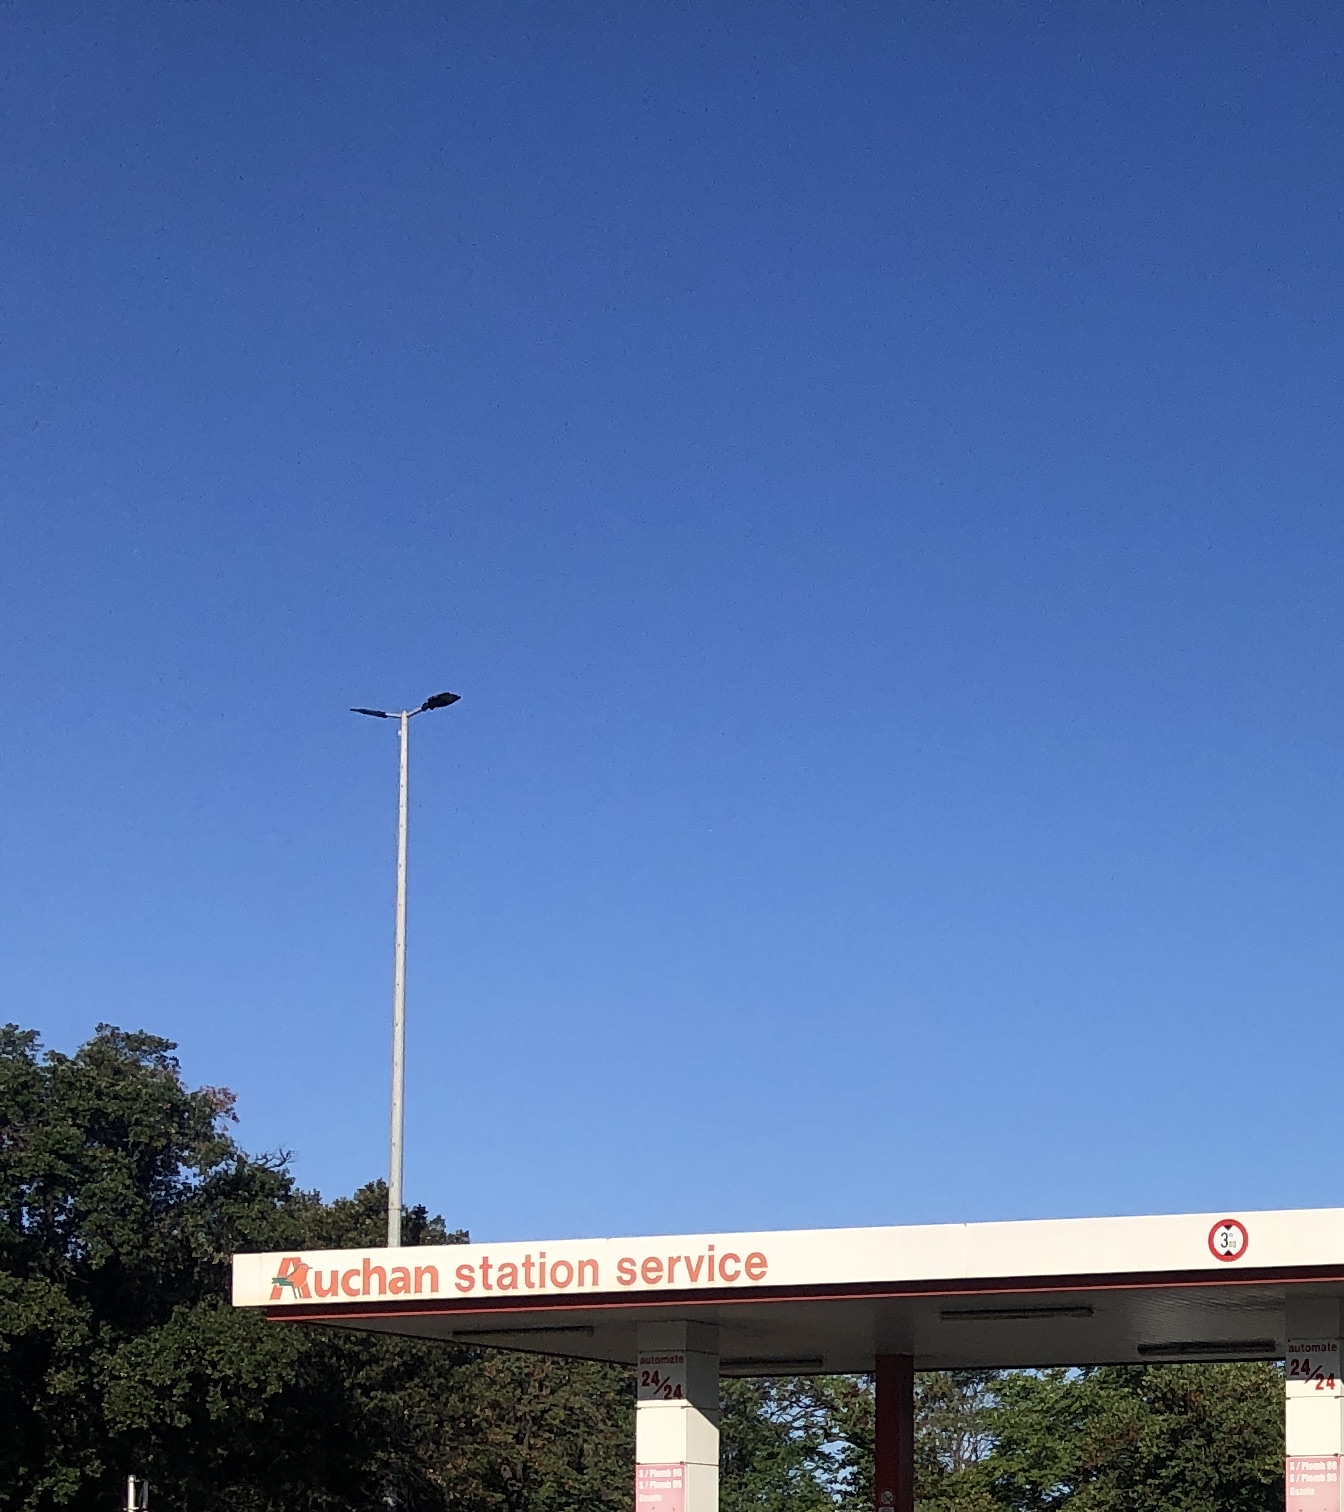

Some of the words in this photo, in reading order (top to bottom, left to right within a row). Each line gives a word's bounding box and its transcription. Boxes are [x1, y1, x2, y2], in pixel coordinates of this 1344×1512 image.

[1221, 1232, 1228, 1248] 3
[270, 1257, 439, 1300] Auchan
[455, 1252, 598, 1292] station
[617, 1245, 768, 1287] service
[1288, 1343, 1337, 1353] automate
[640, 1355, 684, 1364] automate
